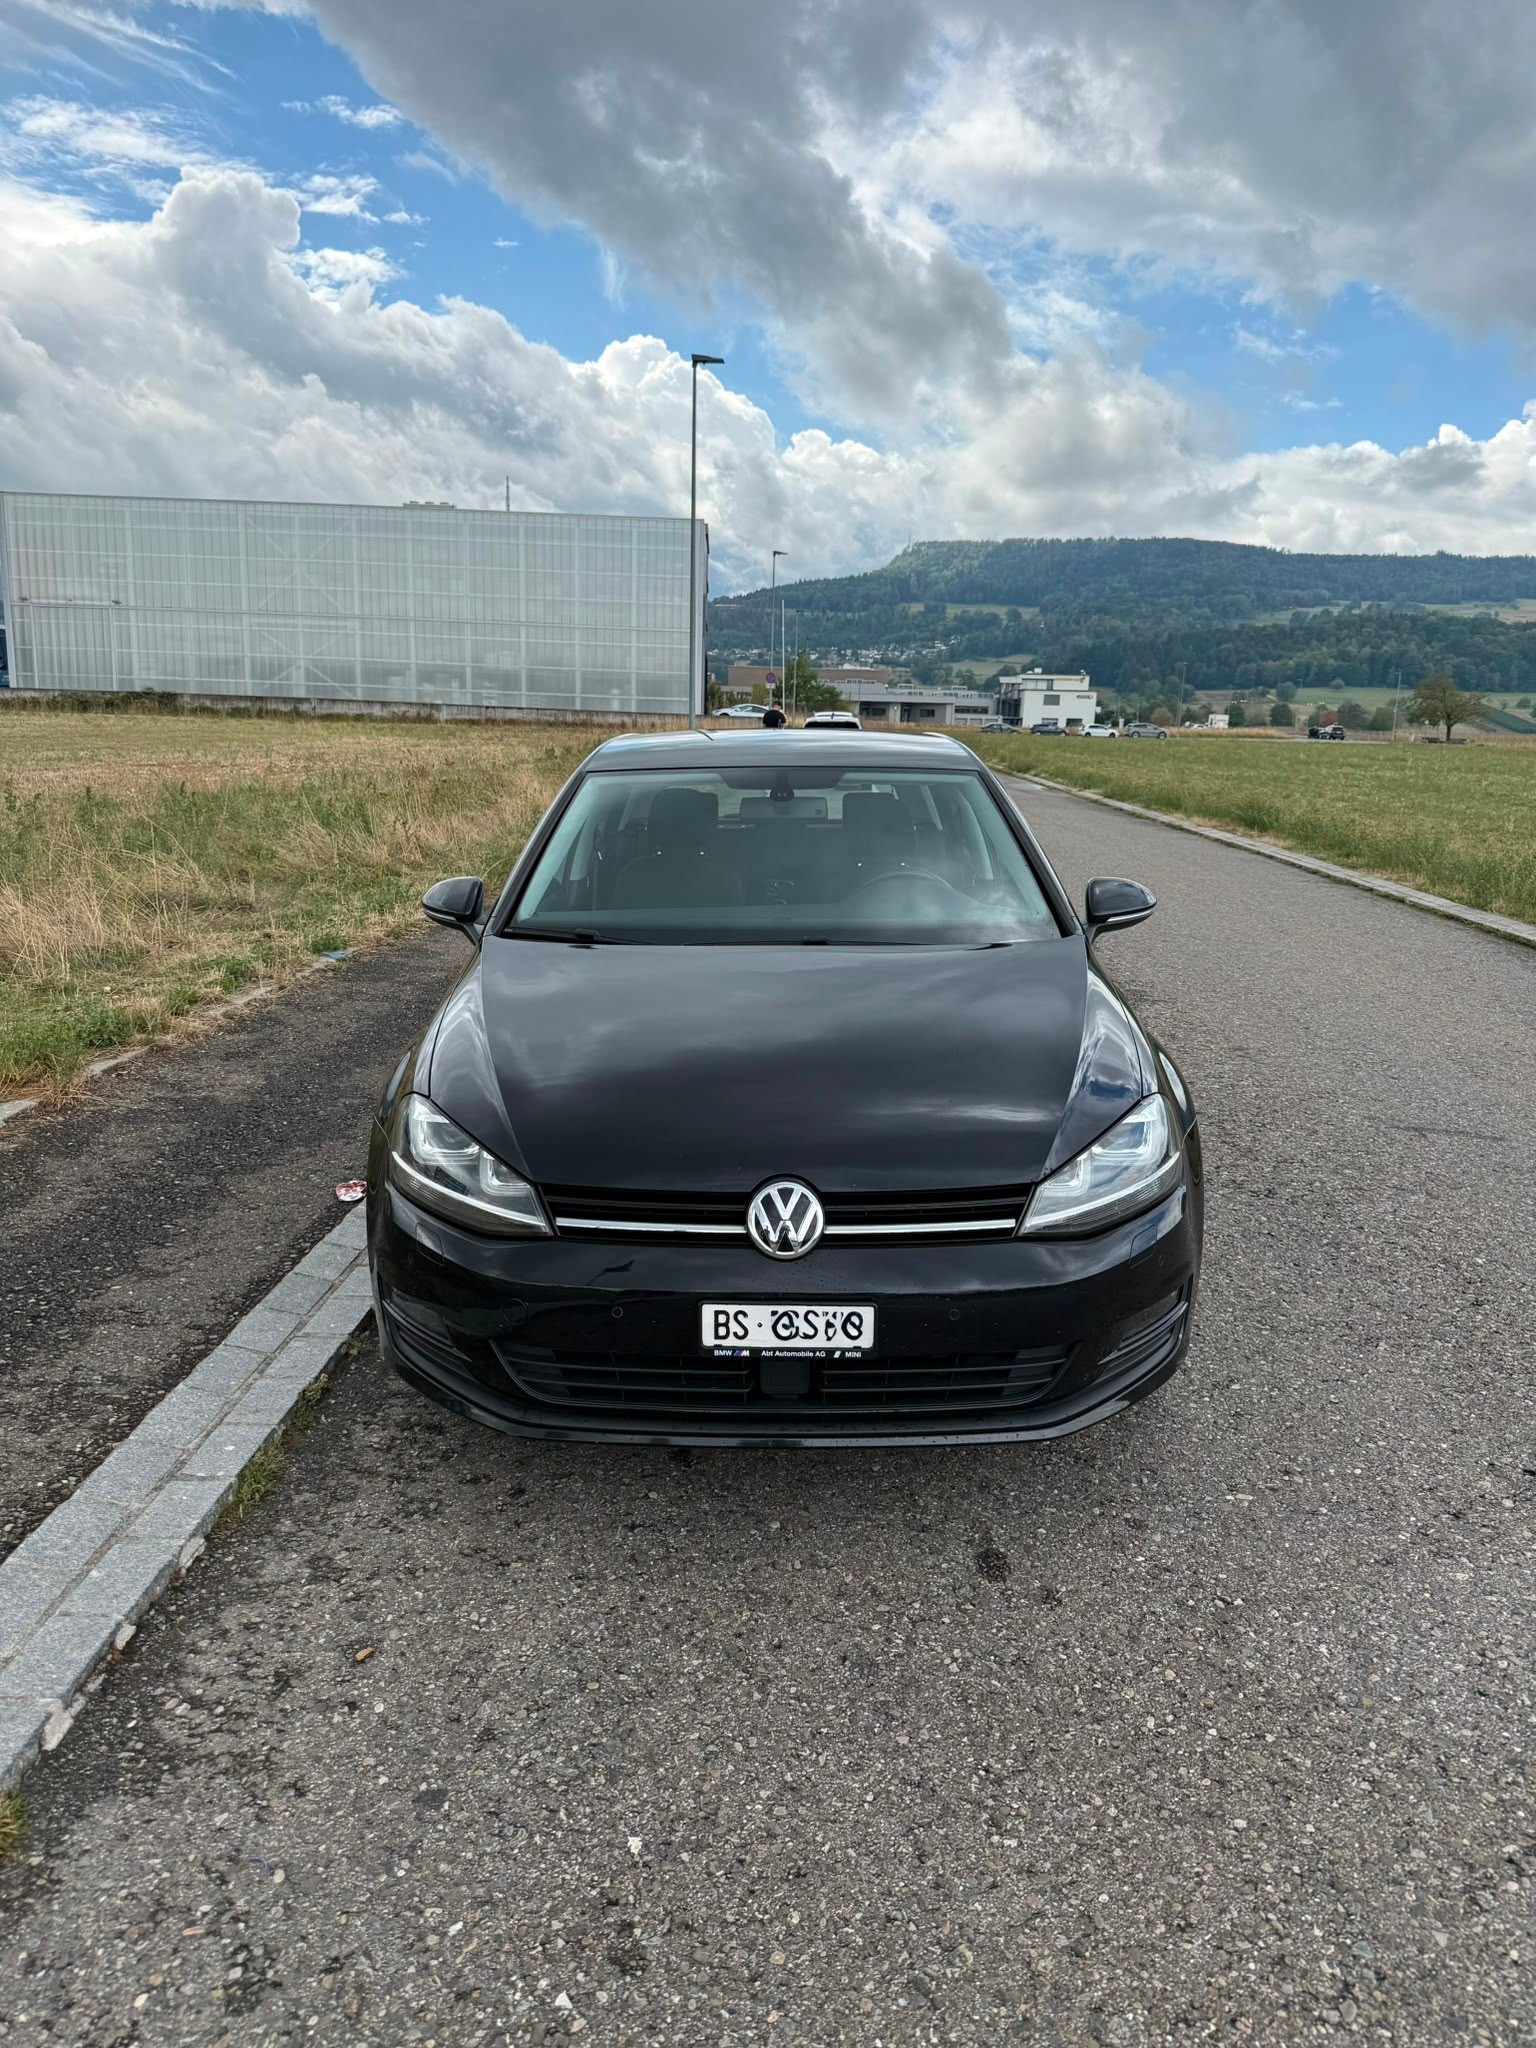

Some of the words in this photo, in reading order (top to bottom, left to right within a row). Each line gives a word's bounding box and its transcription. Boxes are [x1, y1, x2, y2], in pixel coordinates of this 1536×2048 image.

[753, 1186, 819, 1255] VW
[713, 1309, 750, 1341] BS
[713, 1349, 733, 1357] BMW
